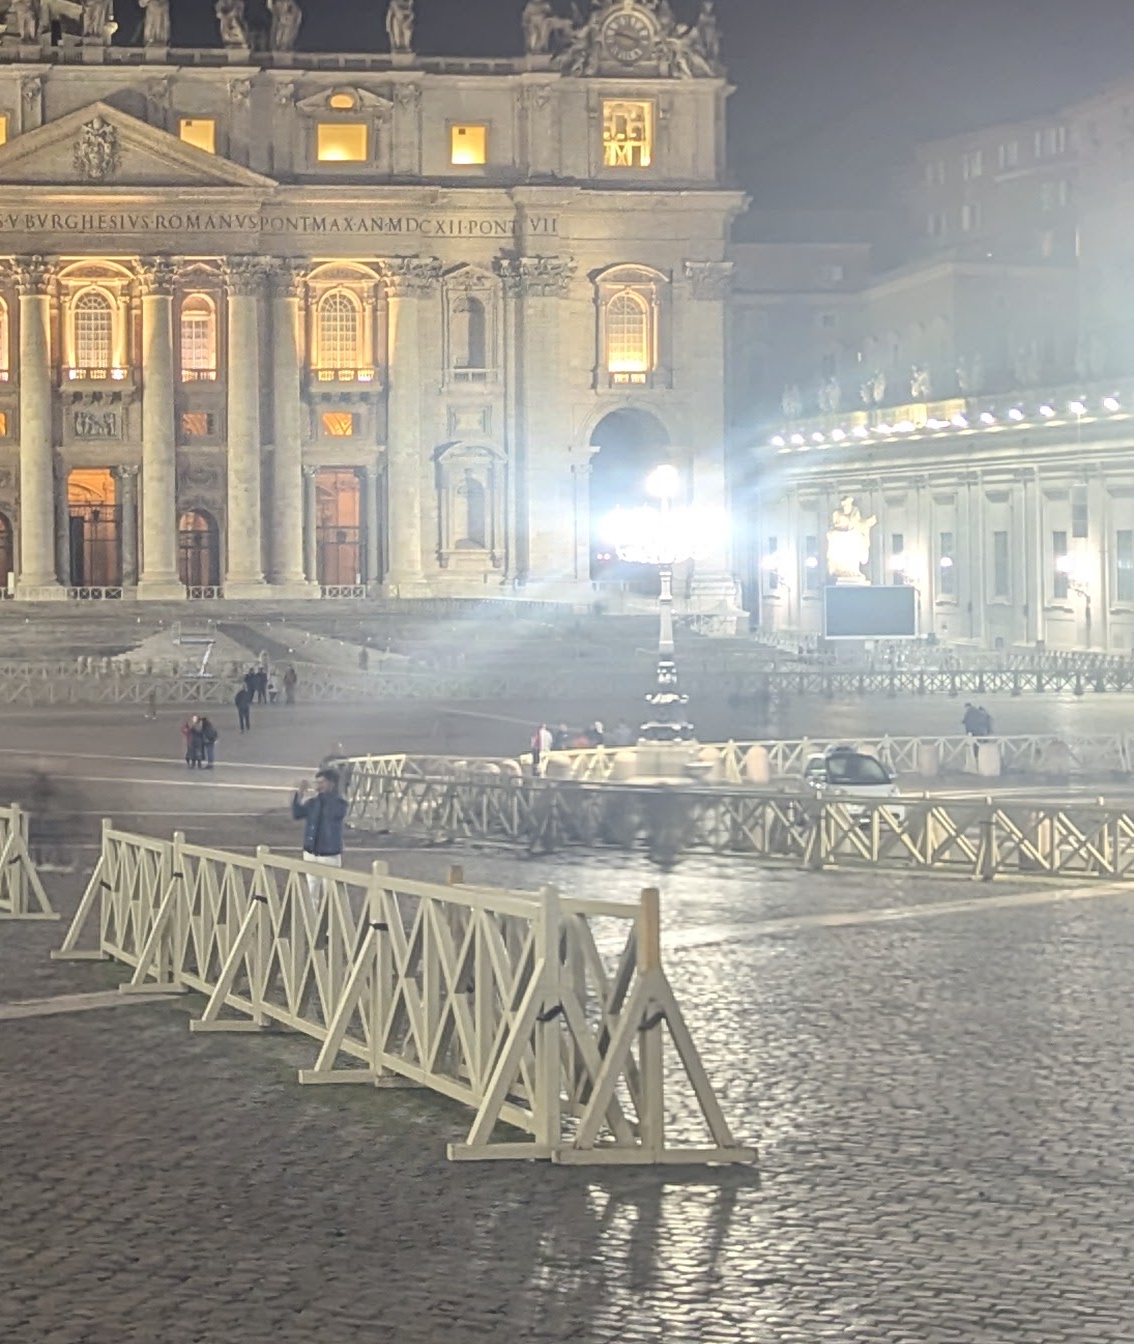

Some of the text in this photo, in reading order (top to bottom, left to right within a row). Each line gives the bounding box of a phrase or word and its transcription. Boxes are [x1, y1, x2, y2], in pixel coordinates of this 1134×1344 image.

[7, 213, 19, 229] V
[25, 214, 150, 230] BVRGHESIVS
[155, 214, 259, 230] ROMANVS
[259, 215, 311, 232] PONT
[311, 216, 354, 232] MAX
[357, 217, 384, 232] AN
[387, 216, 463, 234] MDCXII
[468, 219, 517, 234] PONT
[529, 217, 557, 233] VII
